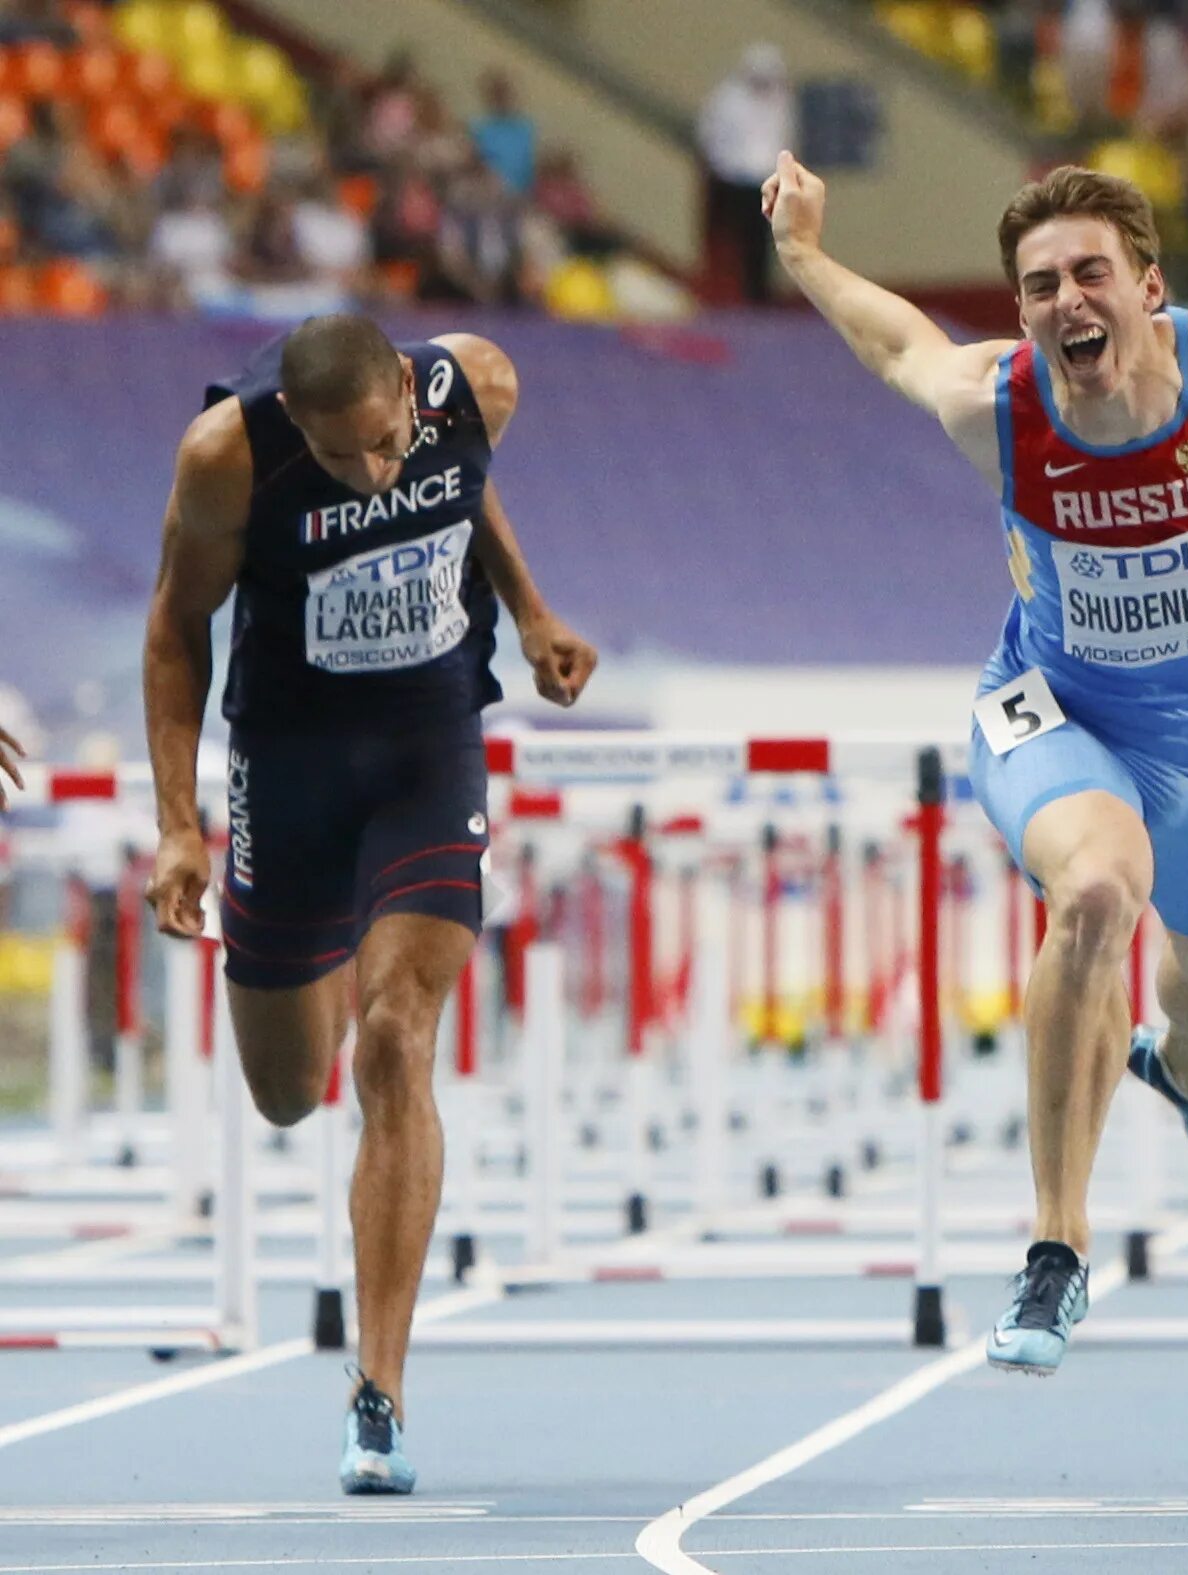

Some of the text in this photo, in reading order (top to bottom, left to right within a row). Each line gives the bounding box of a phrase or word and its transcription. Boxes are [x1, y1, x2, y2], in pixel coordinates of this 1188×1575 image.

[320, 466, 461, 540] FRANCE
[357, 533, 451, 582] TDK
[315, 643, 418, 667] MOSCOW
[1072, 641, 1180, 662] MOSCOW
[1001, 691, 1041, 738] 5
[229, 748, 252, 874] FRANCE
